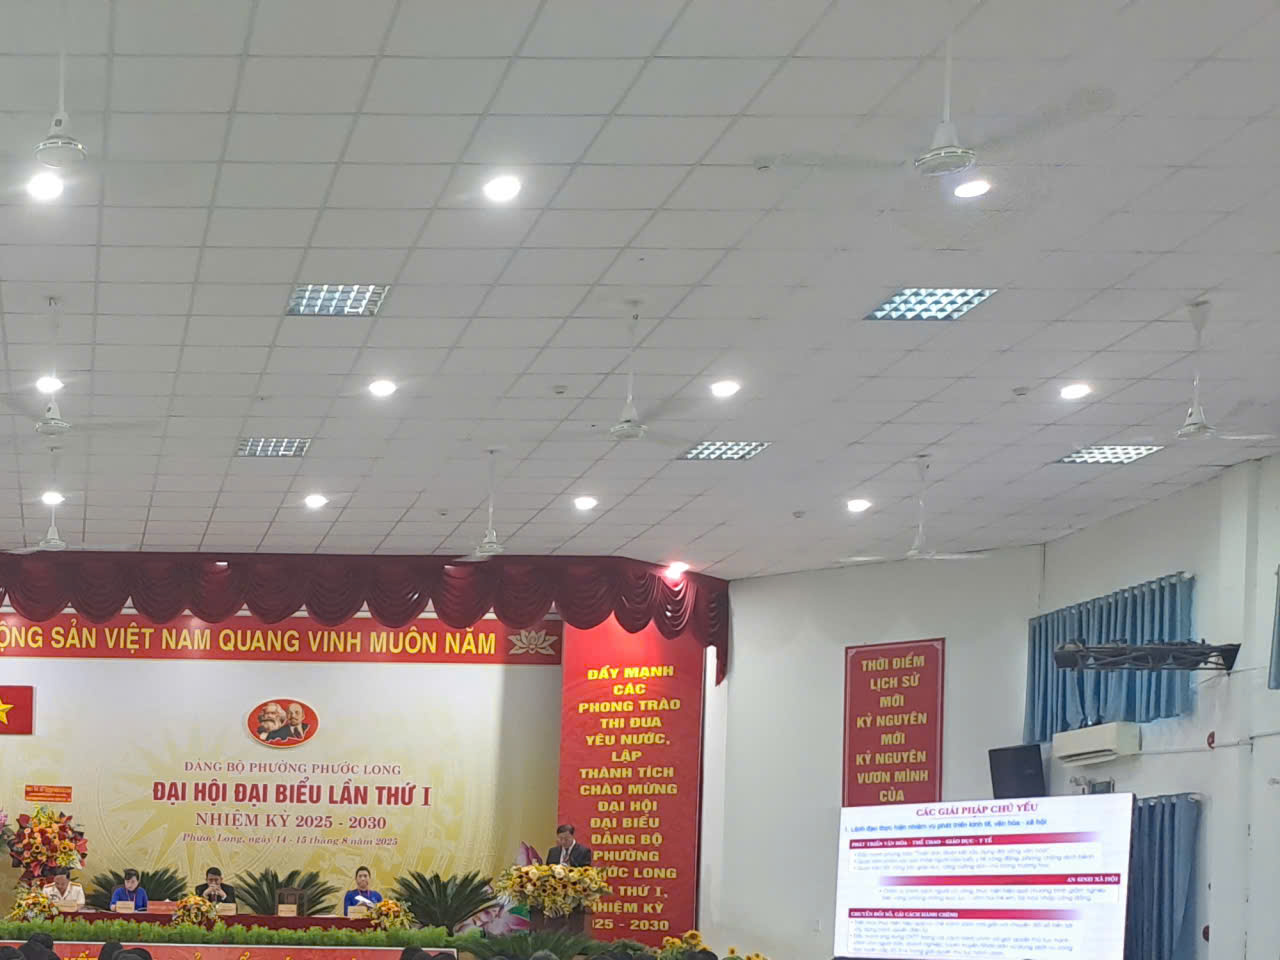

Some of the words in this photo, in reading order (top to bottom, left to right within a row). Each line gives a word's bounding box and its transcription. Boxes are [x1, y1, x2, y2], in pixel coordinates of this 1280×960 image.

[51, 619, 96, 649] SẢN
[104, 622, 155, 654] VIỆT
[161, 628, 211, 651] NAM
[219, 629, 300, 652] QUANG
[308, 631, 361, 653] VINH
[370, 626, 437, 654] MUÔN
[445, 627, 496, 655] NĂM
[861, 657, 888, 672] THỜI
[892, 652, 925, 669] ĐIỂM
[623, 666, 674, 680] MẠNH
[613, 682, 646, 696] CÁC
[870, 677, 898, 692] LỊCH
[902, 671, 921, 687] SỬ
[578, 701, 634, 713] PHONG
[638, 697, 681, 711] TRÀO
[879, 693, 904, 708] MỚI
[600, 718, 625, 729] THI
[629, 717, 662, 728] ĐUA
[876, 712, 927, 727] NGUYÊN
[586, 732, 616, 745] YÊU
[880, 732, 905, 746] MỚI
[611, 749, 642, 763] LẬP
[875, 750, 926, 765] NGUYÊN
[184, 758, 222, 772] ĐẢNG
[227, 760, 245, 774] BỘ
[250, 760, 307, 774] PHƯỜNG
[312, 761, 359, 774] PHƯỚC
[363, 764, 401, 775] LONG
[580, 766, 632, 779] THÀNH
[638, 765, 674, 778] TÍCH
[857, 769, 891, 785] VƯƠN
[894, 767, 929, 783] MÌNH
[153, 781, 187, 806] ĐẠI
[194, 778, 227, 806] HỘI
[234, 782, 268, 808] ĐẠI
[275, 776, 322, 804] BIỂU
[328, 778, 368, 805] LẦN
[375, 782, 417, 806] THỨ
[421, 786, 432, 807] I
[580, 782, 622, 796] CHÀO
[628, 781, 678, 795] MỪNG
[879, 786, 905, 802] CỦA
[598, 801, 625, 813] ĐẠI
[630, 799, 658, 813] HỘI
[916, 806, 936, 817] CÁC
[961, 803, 989, 815] PHÁP
[1016, 800, 1039, 813] YẾU
[195, 809, 259, 830] NHIỆM
[265, 809, 291, 828] KỲ
[295, 815, 333, 829] 2025
[348, 816, 387, 830] 2030
[590, 818, 617, 830] ĐẠI
[622, 813, 660, 829] BIỂU
[591, 831, 635, 845] ĐẢNG
[640, 831, 663, 847] BỘ
[593, 848, 659, 861] PHƯỜNG
[634, 868, 677, 879] LONG
[619, 884, 651, 897] THỨ
[643, 901, 664, 914] KỲ
[630, 920, 670, 931] 2030
